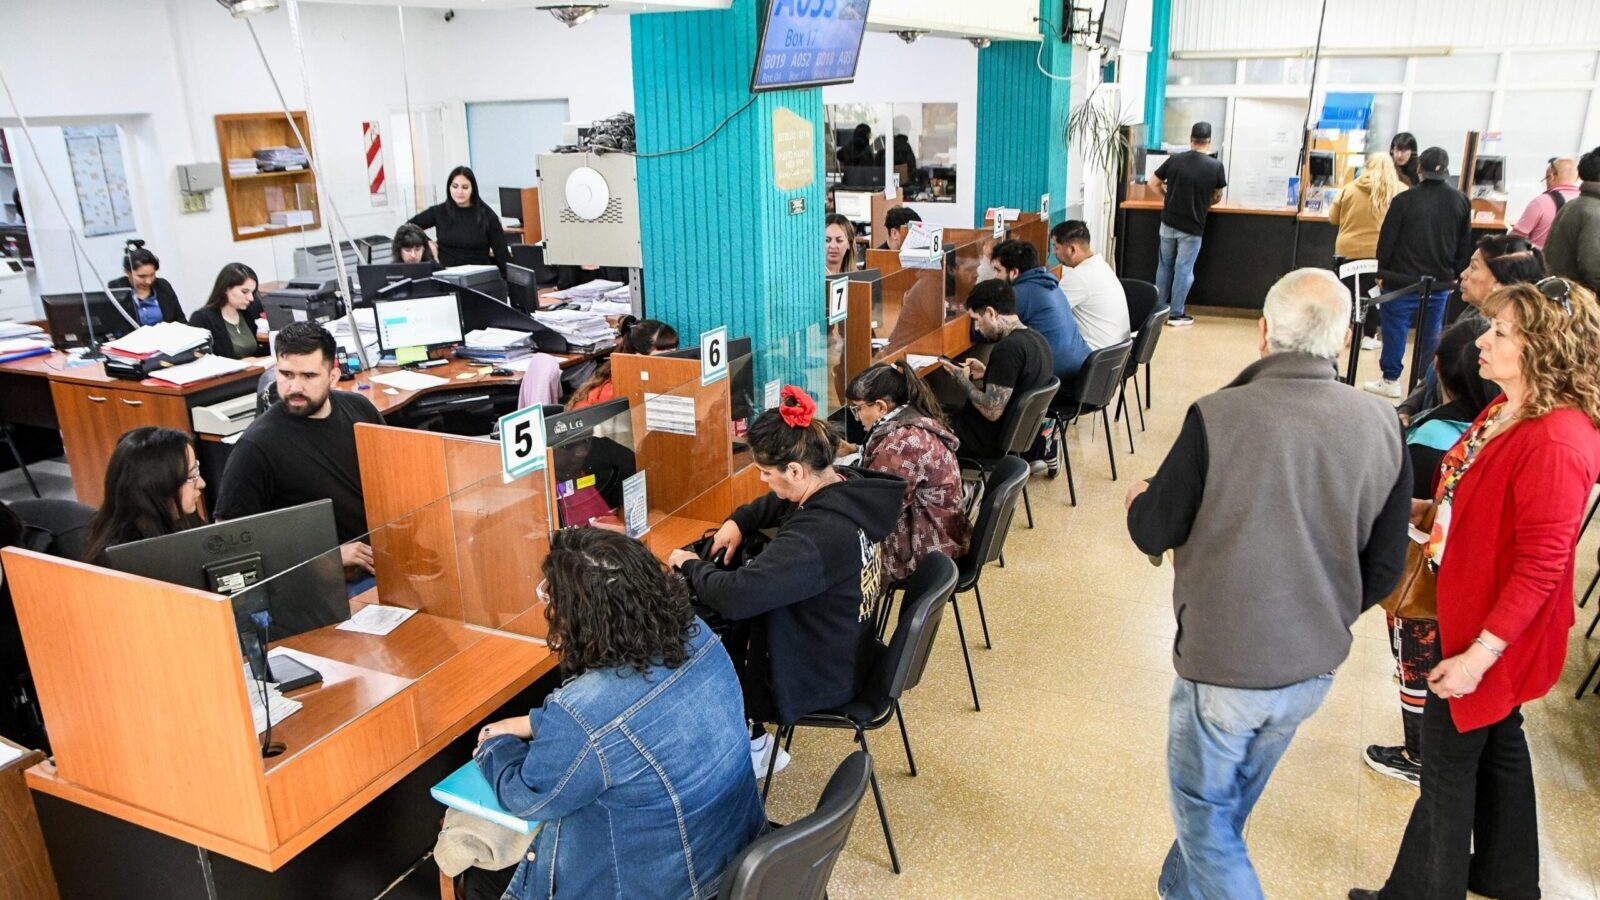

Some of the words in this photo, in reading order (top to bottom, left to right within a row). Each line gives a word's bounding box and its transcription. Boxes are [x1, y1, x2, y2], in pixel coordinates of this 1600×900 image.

[785, 29, 803, 47] Box
[807, 28, 819, 47] 17
[764, 54, 786, 70] B019
[790, 52, 812, 68] A052
[997, 213, 1002, 229] 9
[933, 235, 939, 253] 8
[836, 287, 844, 310] 7
[709, 339, 720, 367] 6
[569, 419, 584, 430] LG
[515, 420, 533, 458] 5
[230, 531, 252, 545] LG
